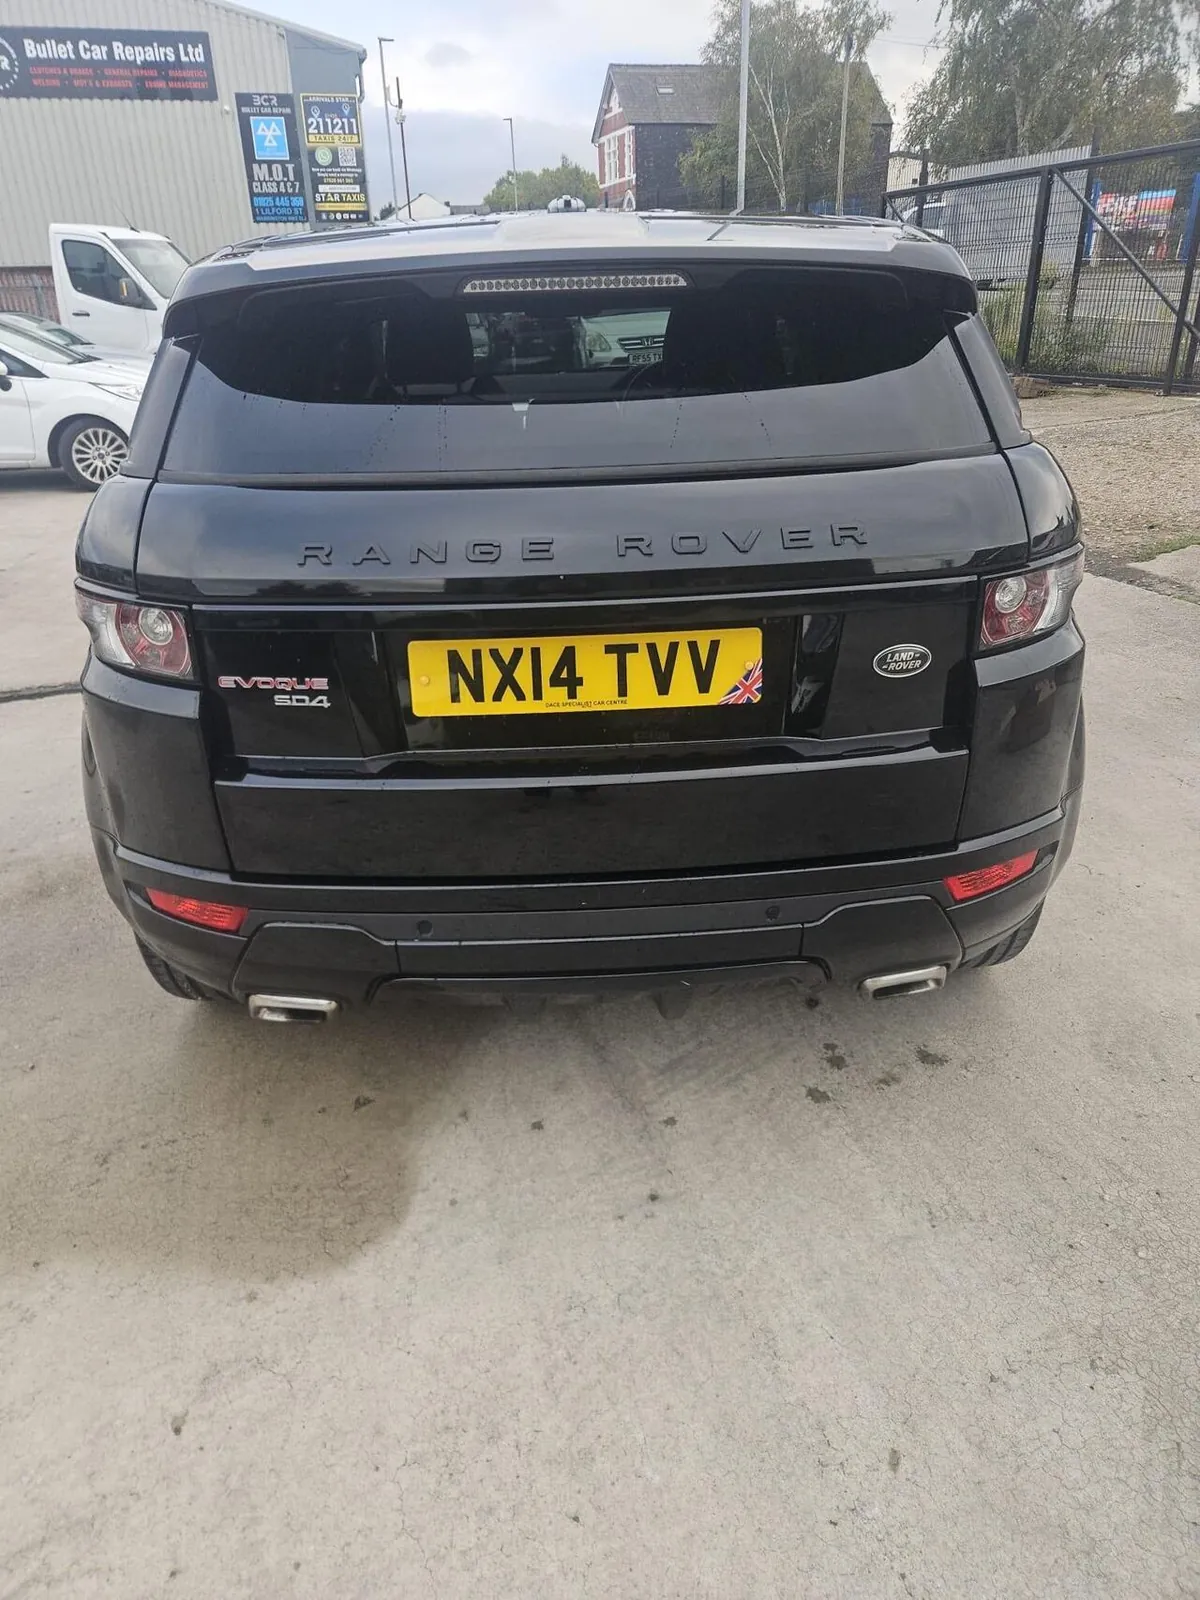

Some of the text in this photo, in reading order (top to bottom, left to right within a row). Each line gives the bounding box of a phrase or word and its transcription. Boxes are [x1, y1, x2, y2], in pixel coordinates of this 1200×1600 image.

[23, 38, 204, 64] Bullet Car Repairs Ltd
[308, 117, 358, 134] 211211
[252, 163, 295, 182] M.O.T
[252, 181, 279, 193] CLASS
[279, 182, 286, 193] 4
[293, 182, 300, 193] 7
[315, 192, 366, 202] STAR TAXIS
[297, 522, 869, 566] RANGE ROVER
[886, 651, 914, 663] LAND
[446, 638, 722, 704] NX14 TVV
[887, 660, 921, 671] ROVER
[217, 675, 330, 691] EVOQUE
[273, 694, 331, 709] SD4
[561, 700, 592, 708] SPECIALIST
